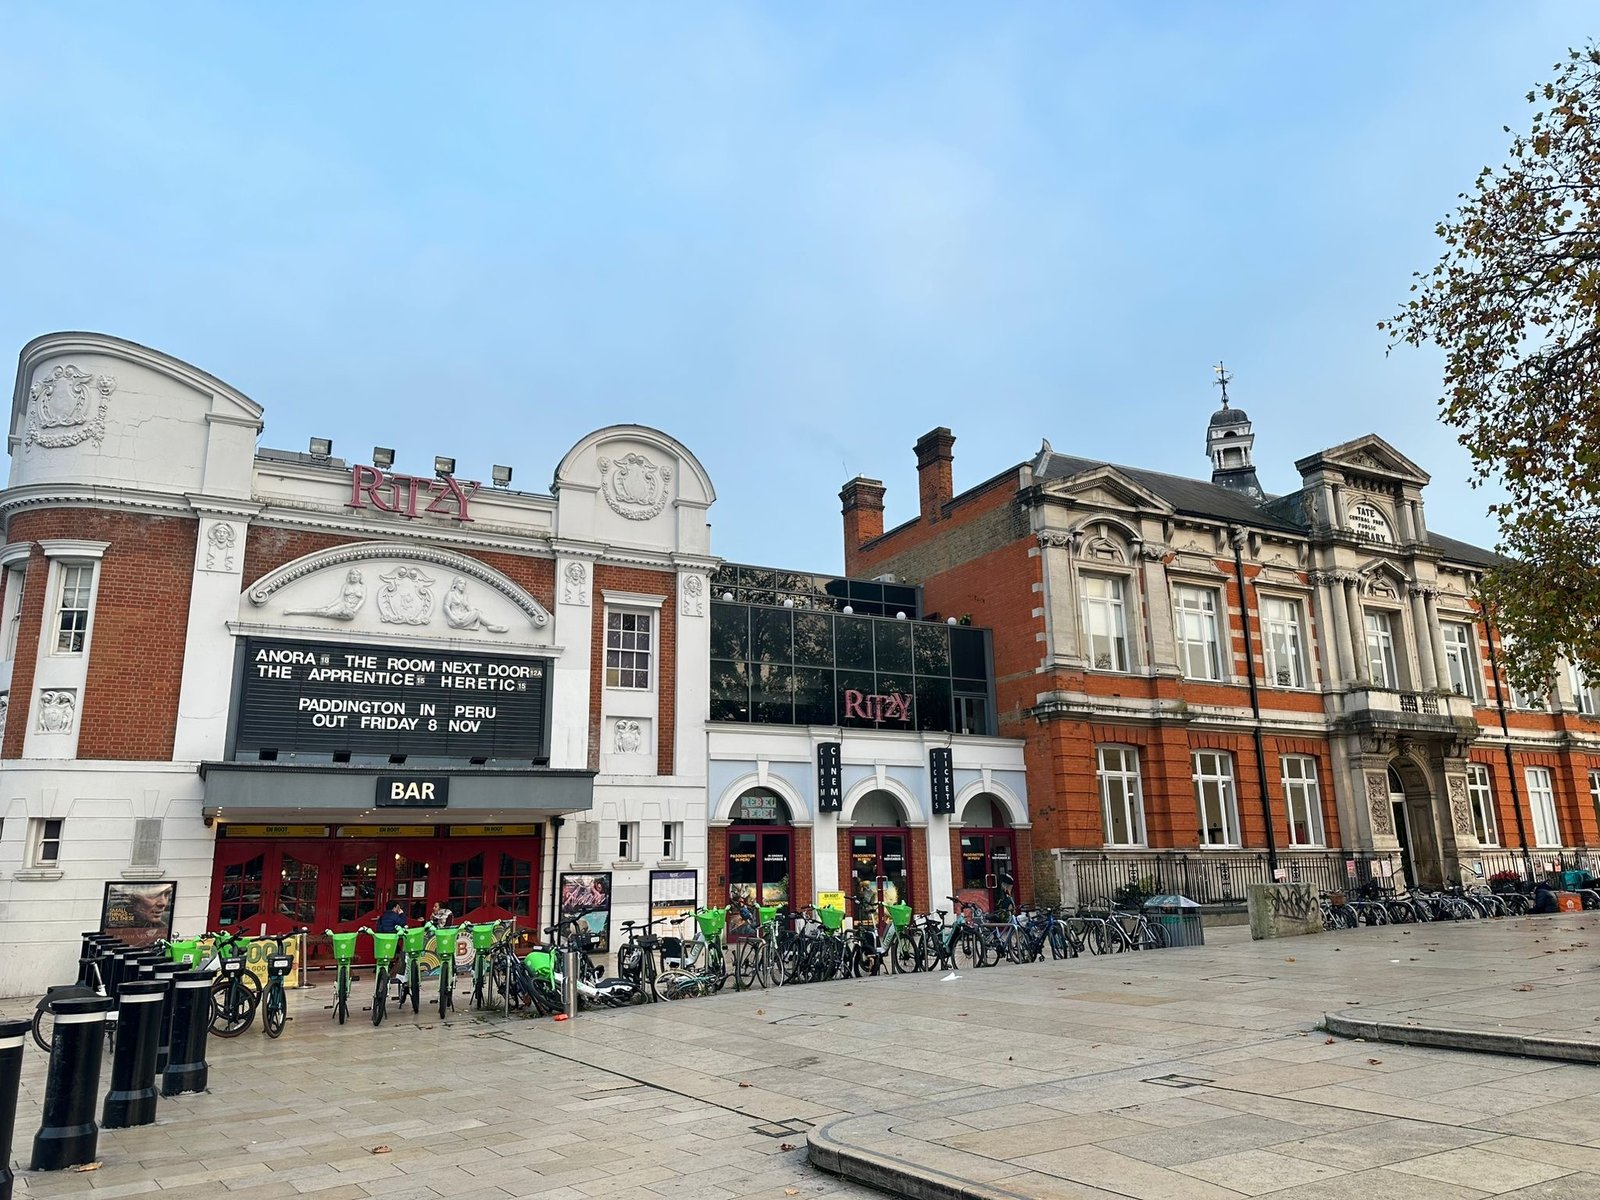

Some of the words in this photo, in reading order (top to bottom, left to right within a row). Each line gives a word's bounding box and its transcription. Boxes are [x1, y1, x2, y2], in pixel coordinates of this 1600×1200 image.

[1349, 515, 1370, 523] CENTRAL
[1357, 506, 1375, 518] TATE
[1358, 523, 1376, 531] PUBLIC
[255, 649, 317, 666] ANORA
[344, 655, 378, 669] THE
[387, 657, 435, 673] ROOM
[442, 661, 483, 675] NEXT
[488, 664, 530, 678] DOOR
[257, 665, 293, 679] THE
[308, 668, 415, 686] APPRENTICE
[417, 676, 426, 685] 15
[441, 676, 516, 691] HERETIC
[518, 681, 527, 690] 15
[298, 697, 406, 716] PADDINGTON
[420, 703, 436, 717] IN
[455, 705, 497, 719] PERU
[312, 713, 348, 728] OUT
[361, 716, 420, 731] FRIDAY
[428, 718, 438, 732] 8
[448, 720, 481, 733] NOV
[830, 747, 839, 807] CINEMA
[932, 752, 940, 810] TICKETS
[943, 752, 951, 809] TICKETS
[391, 782, 436, 800] BAR
